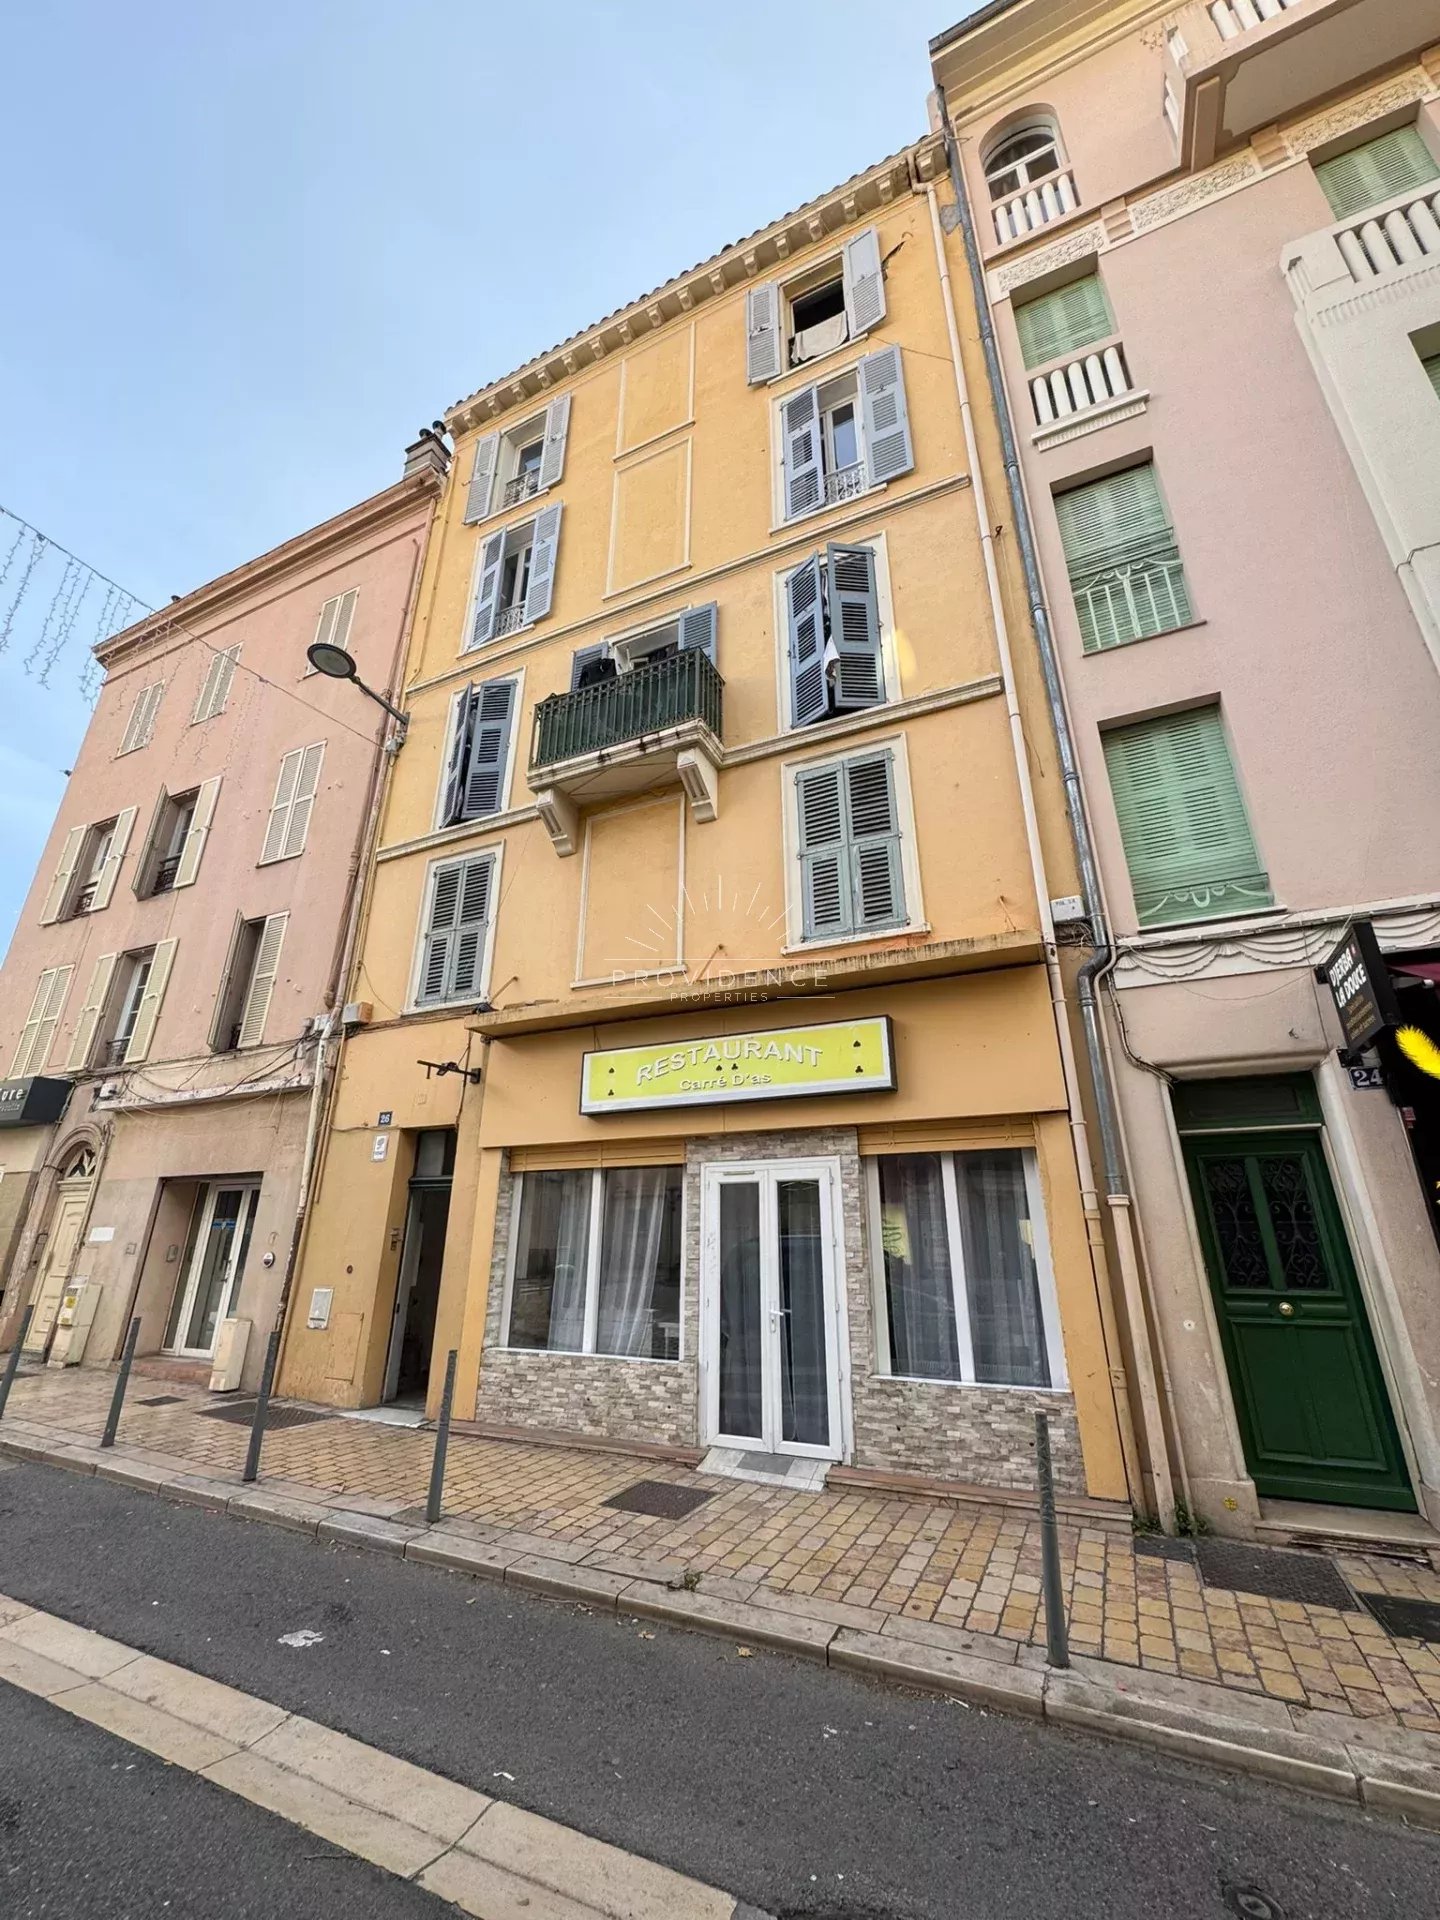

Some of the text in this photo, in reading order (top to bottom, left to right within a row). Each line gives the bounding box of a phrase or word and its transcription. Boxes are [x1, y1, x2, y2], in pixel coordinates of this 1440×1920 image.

[1335, 986, 1347, 1009] LA
[1343, 963, 1367, 1000] DOUCE
[636, 1040, 823, 1085] RESTAURANT
[679, 1072, 772, 1091] Carré D'as
[1353, 1069, 1384, 1087] 24
[380, 1114, 391, 1124] 26
